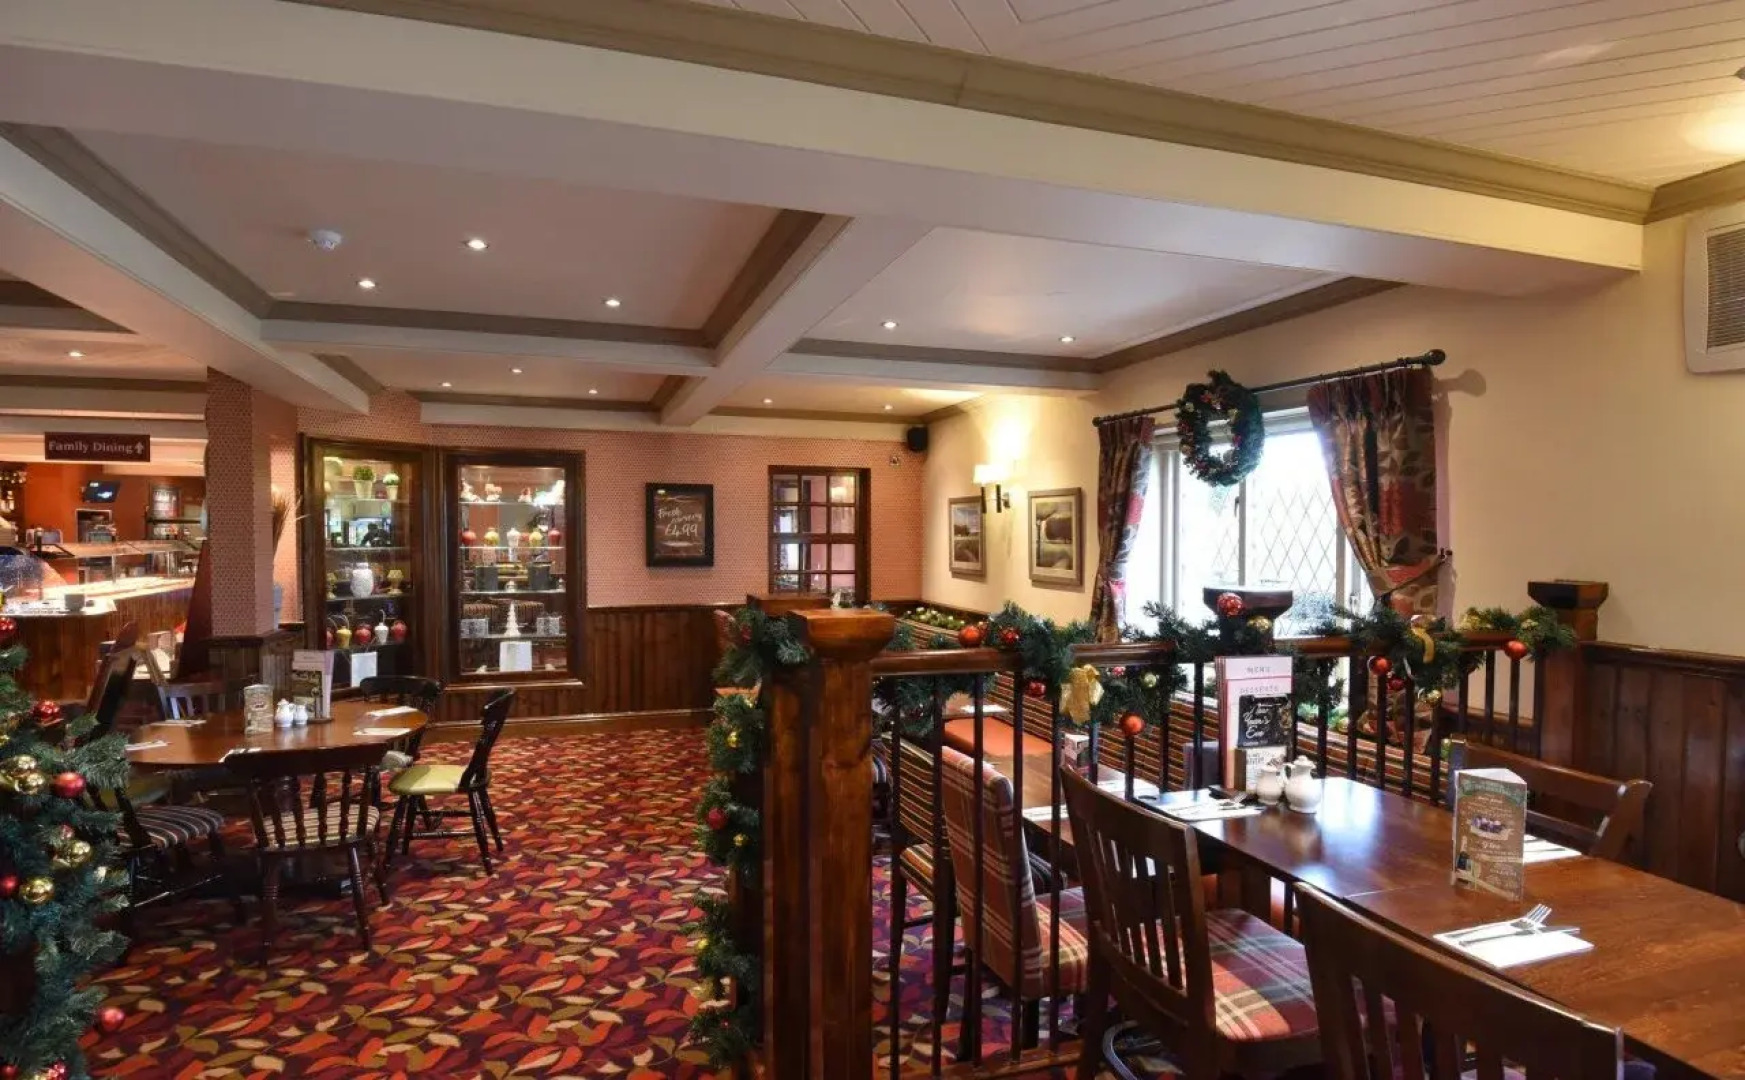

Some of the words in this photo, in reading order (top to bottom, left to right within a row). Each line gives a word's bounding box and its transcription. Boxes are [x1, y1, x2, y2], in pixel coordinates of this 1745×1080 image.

[48, 440, 89, 454] Family
[93, 442, 133, 455] Dining
[664, 523, 698, 537] £4.99
